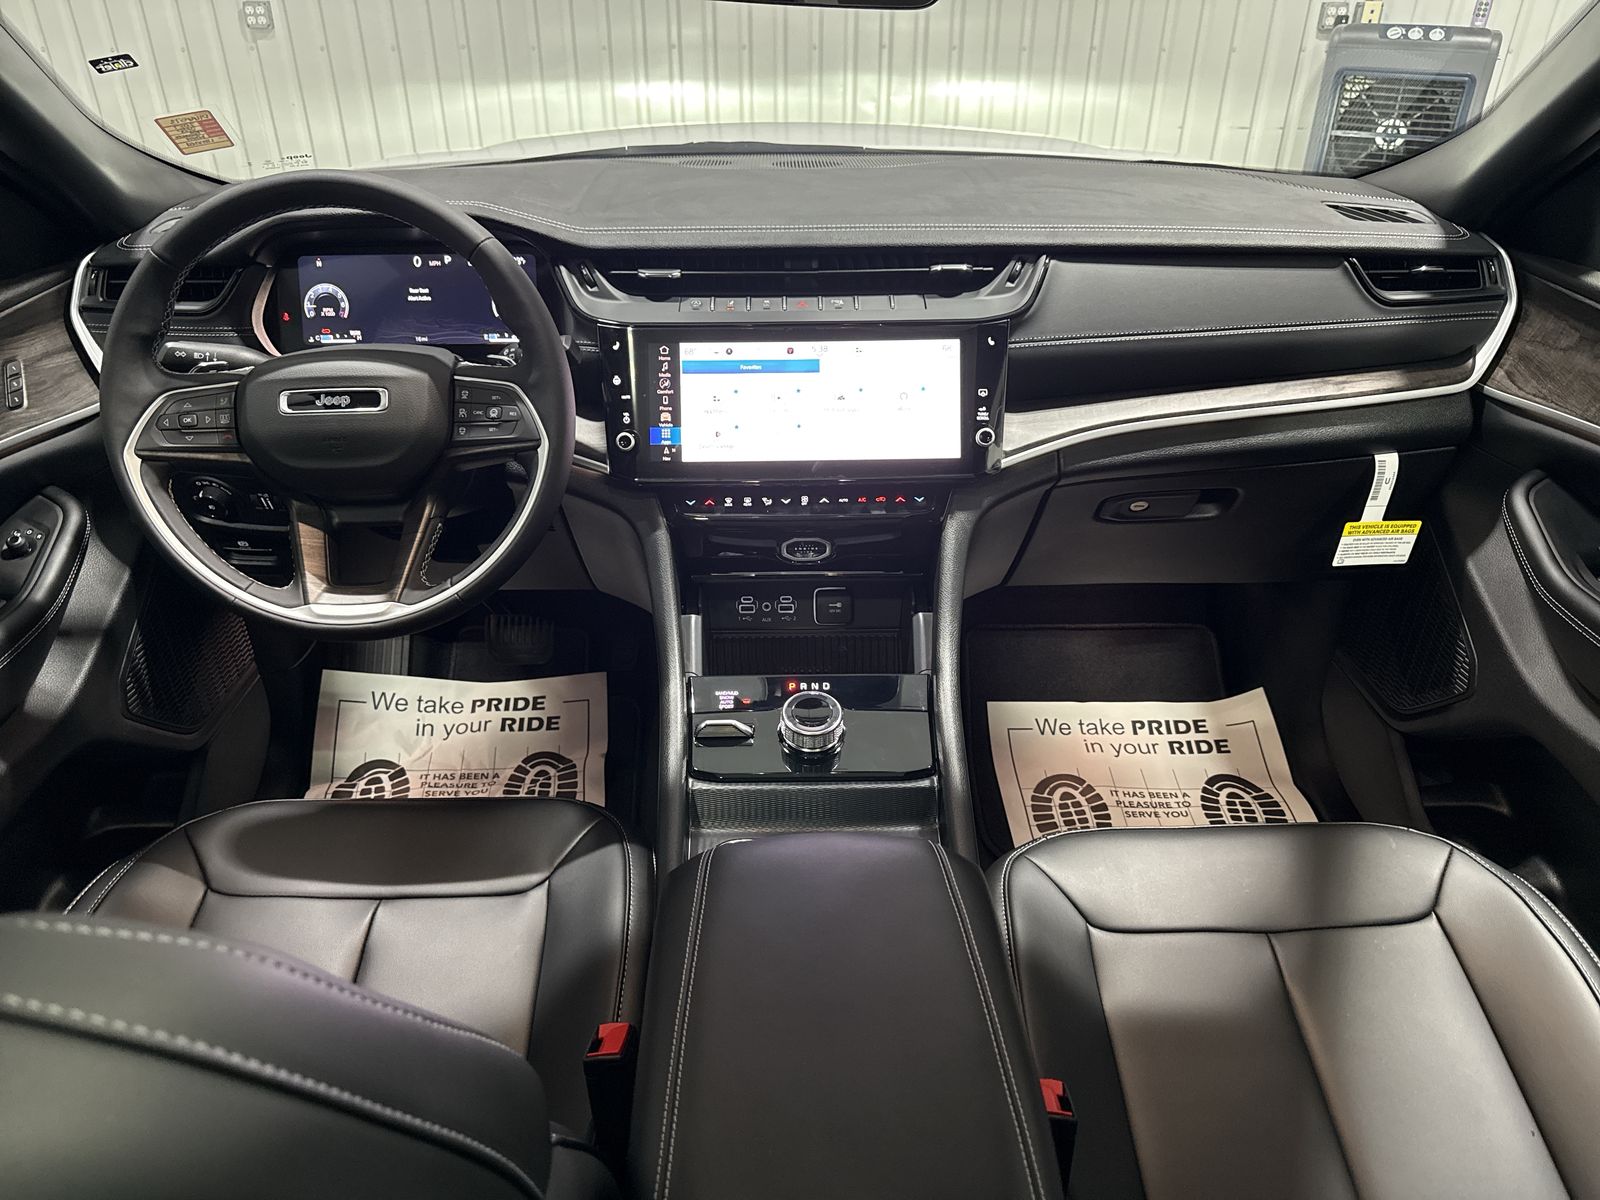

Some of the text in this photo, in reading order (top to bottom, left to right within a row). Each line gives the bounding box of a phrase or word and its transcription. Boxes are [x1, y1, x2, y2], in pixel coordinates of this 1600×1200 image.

[444, 255, 452, 264] P
[315, 394, 351, 408] Jeep
[822, 682, 830, 690] D
[371, 691, 547, 714] We take PRIDE
[415, 716, 561, 741] in your RIDE
[1034, 718, 1209, 736] We take PRIDE
[1083, 739, 1231, 758] in your RIDE
[433, 772, 456, 780] HAS
[459, 772, 489, 780] BEEN
[420, 781, 478, 789] PLEASURE
[464, 788, 489, 796] YOU
[1122, 790, 1146, 798] HAS
[1148, 791, 1179, 799] BEEN
[1115, 800, 1192, 809] PLEASURE TO
[1124, 810, 1189, 818] SERVE YOU
